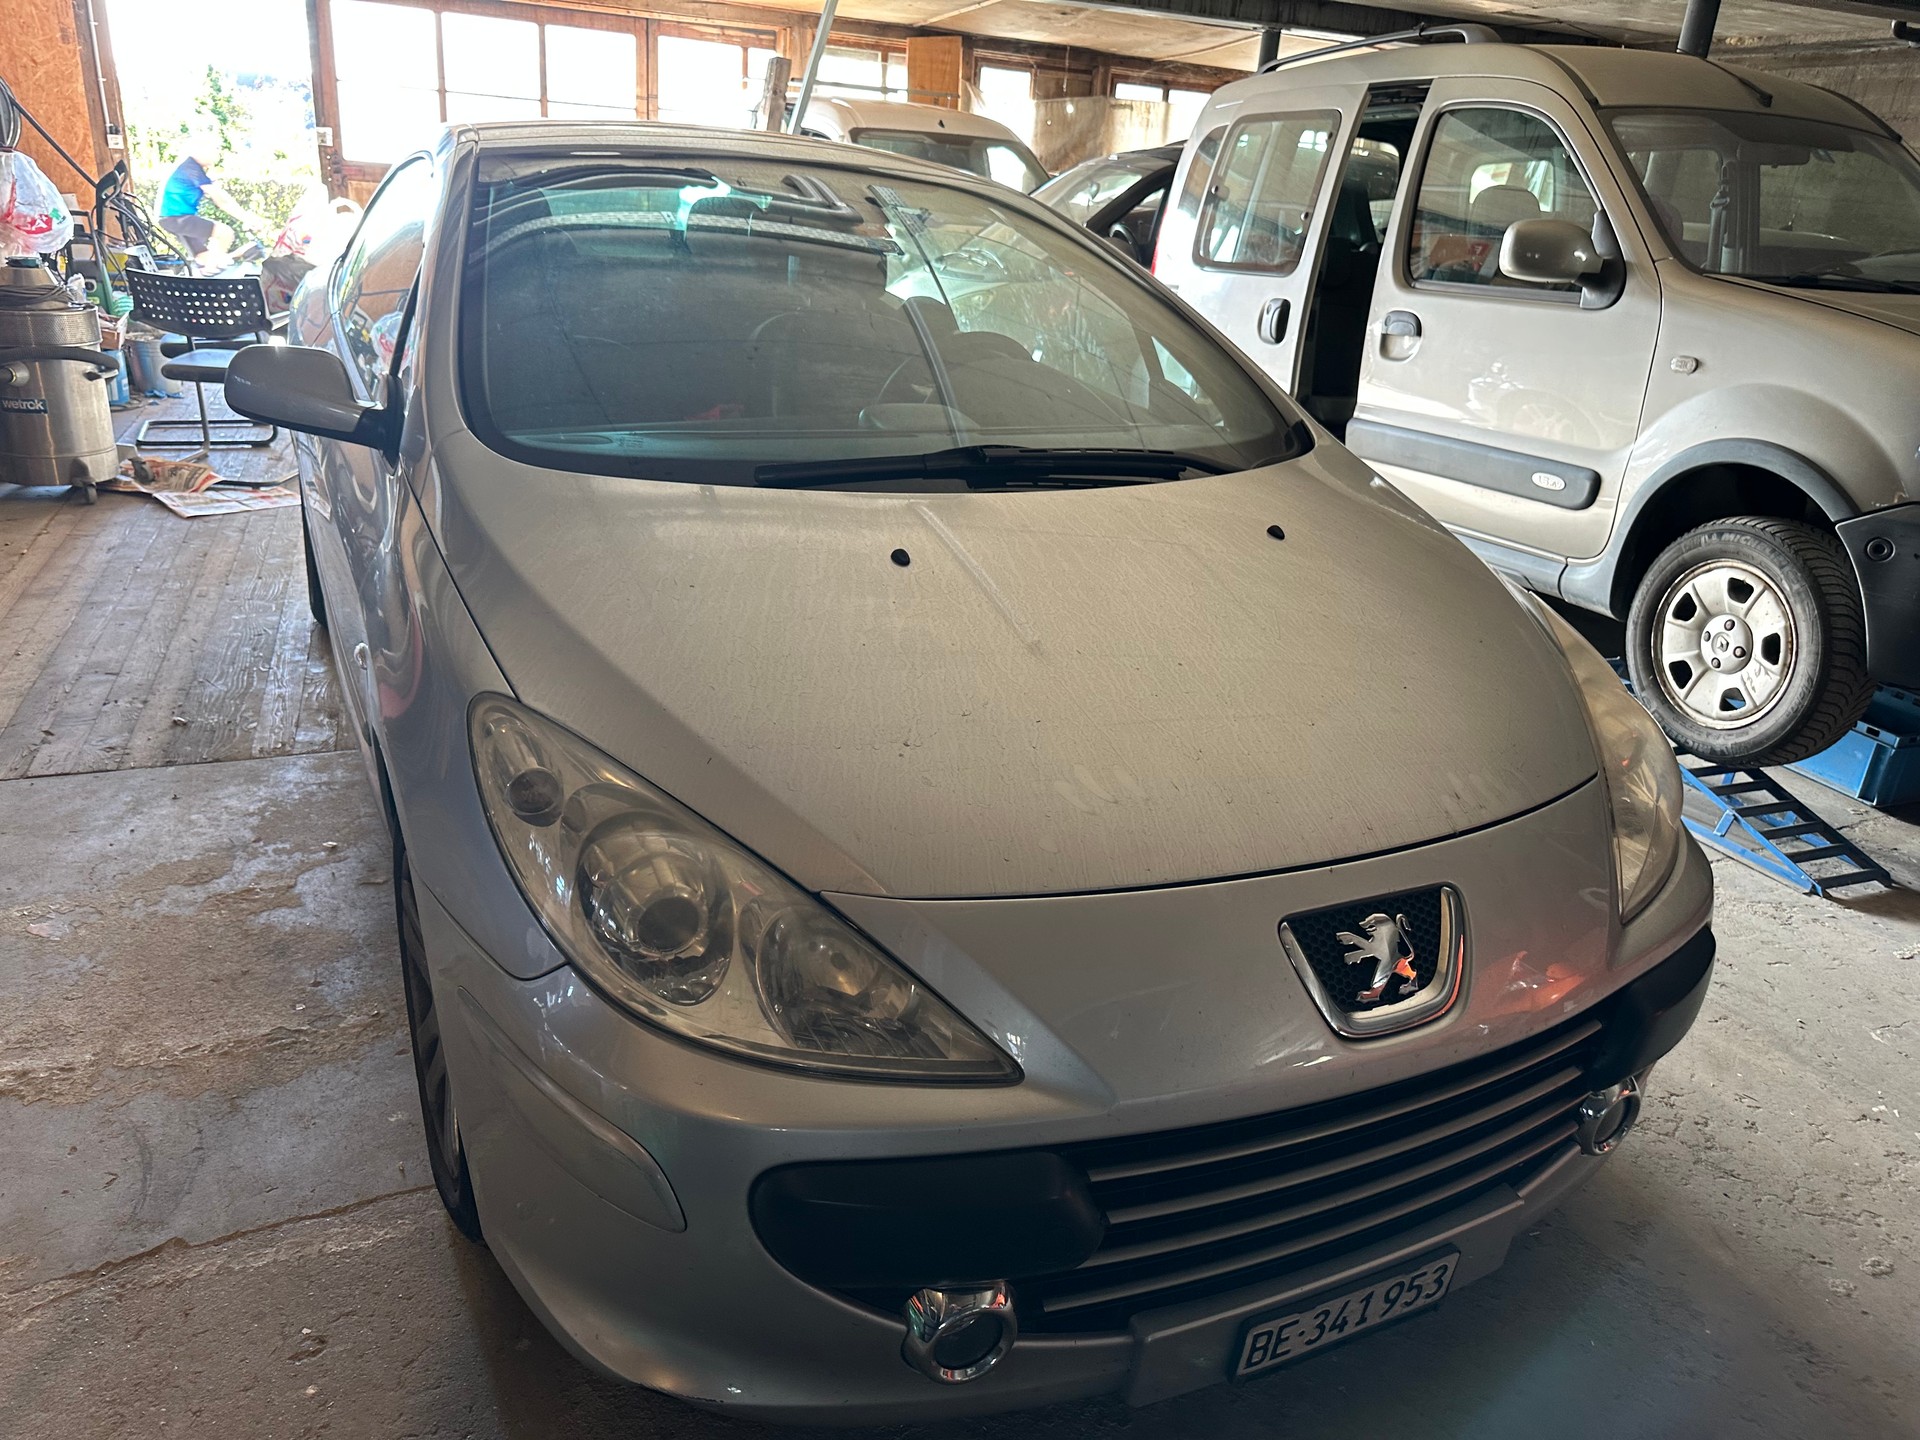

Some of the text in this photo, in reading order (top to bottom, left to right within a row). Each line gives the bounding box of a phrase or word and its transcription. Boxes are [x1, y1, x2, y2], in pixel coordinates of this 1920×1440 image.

[2, 399, 45, 410] wetrok
[1721, 532, 1790, 569] MICHELIN
[1379, 1263, 1449, 1318] 953
